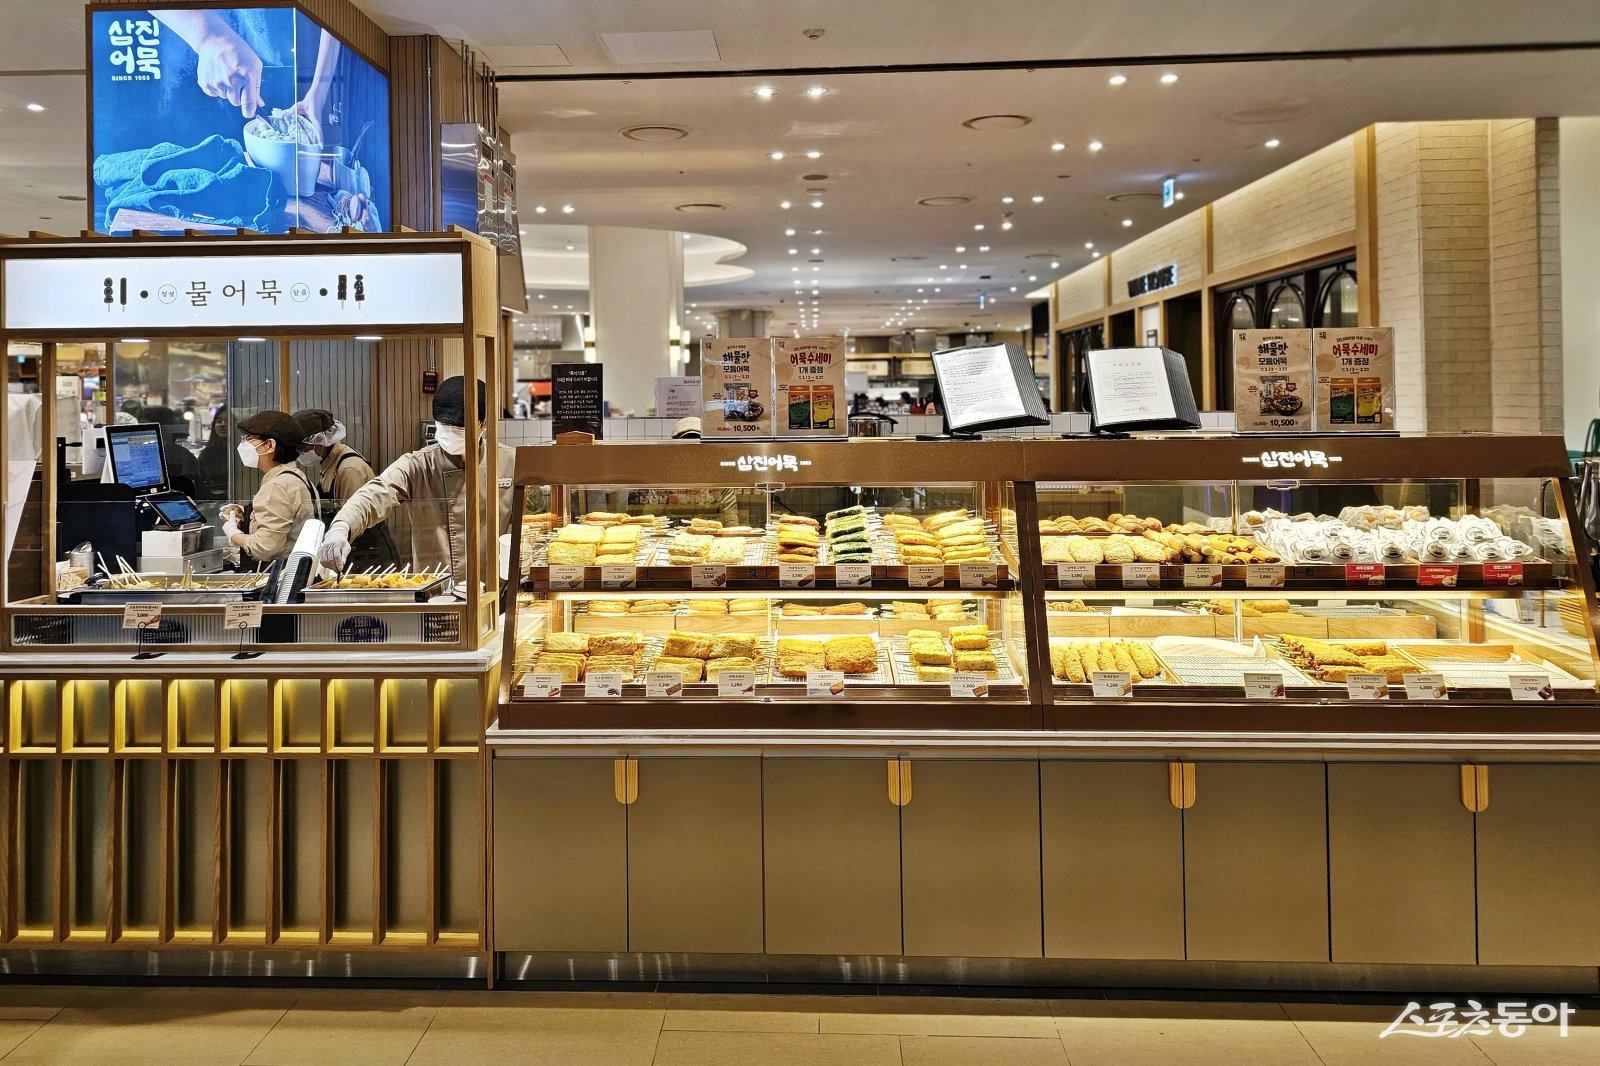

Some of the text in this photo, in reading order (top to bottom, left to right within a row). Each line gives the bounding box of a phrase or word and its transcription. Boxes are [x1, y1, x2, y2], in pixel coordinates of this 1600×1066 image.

[108, 19, 160, 46] 삼진
[109, 46, 161, 80] 어묵
[185, 279, 282, 307] 물어묵
[1258, 342, 1288, 356] 해물맛
[1332, 343, 1378, 356] 어묵수세미
[722, 351, 750, 364] 해물맛
[790, 352, 832, 365] 어묵수세미
[1342, 358, 1352, 366] 1개
[799, 366, 808, 374] 1개
[737, 454, 799, 472] 삼진어묵
[1260, 450, 1329, 468] 삼진어묵
